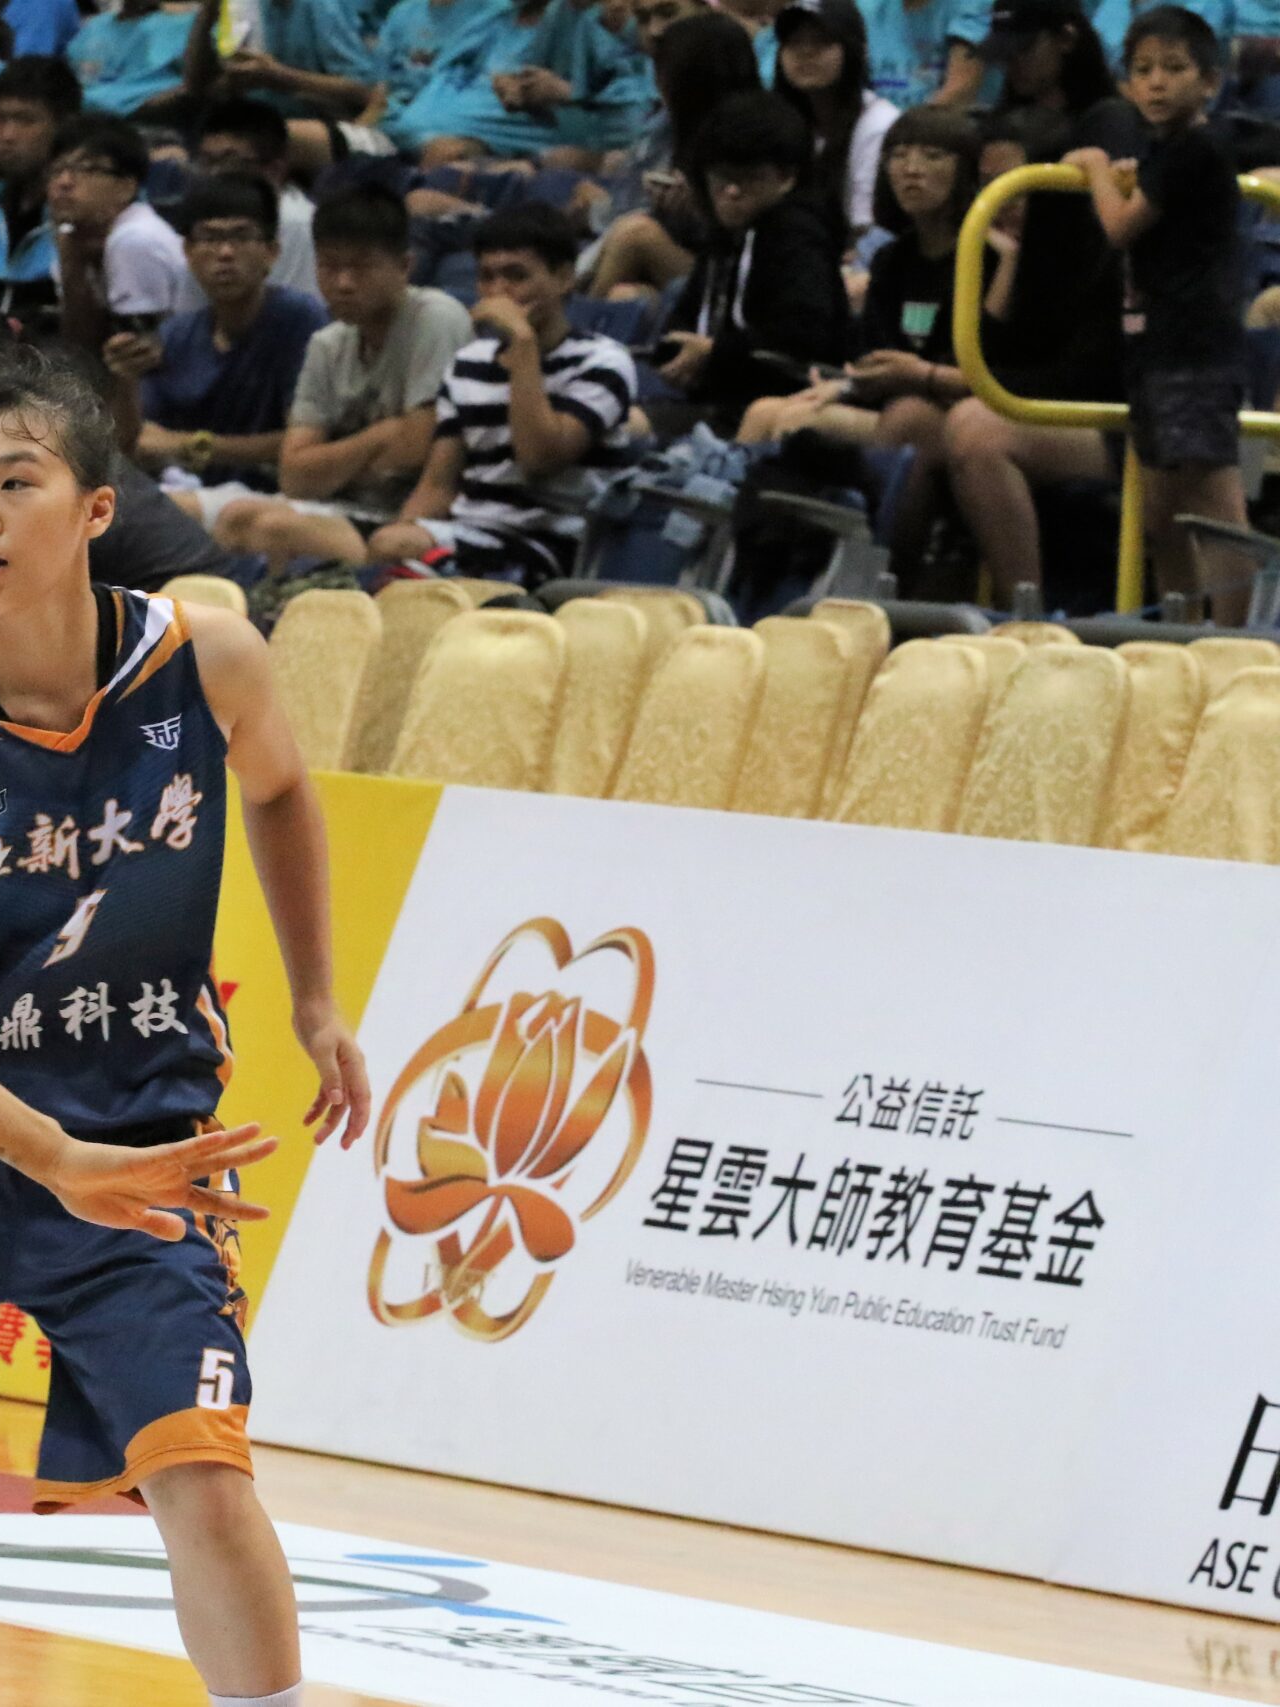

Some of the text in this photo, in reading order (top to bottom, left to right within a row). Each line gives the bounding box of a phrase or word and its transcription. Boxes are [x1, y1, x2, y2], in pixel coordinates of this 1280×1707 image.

[833, 1074, 986, 1140] 公益信託
[641, 1137, 1106, 1287] 星雲大師教育基金
[625, 1258, 1068, 1350] Venerable Master Hsing Yun Public Education Trust Fund
[196, 1347, 236, 1411] 5
[1188, 1537, 1269, 1594] ASE
